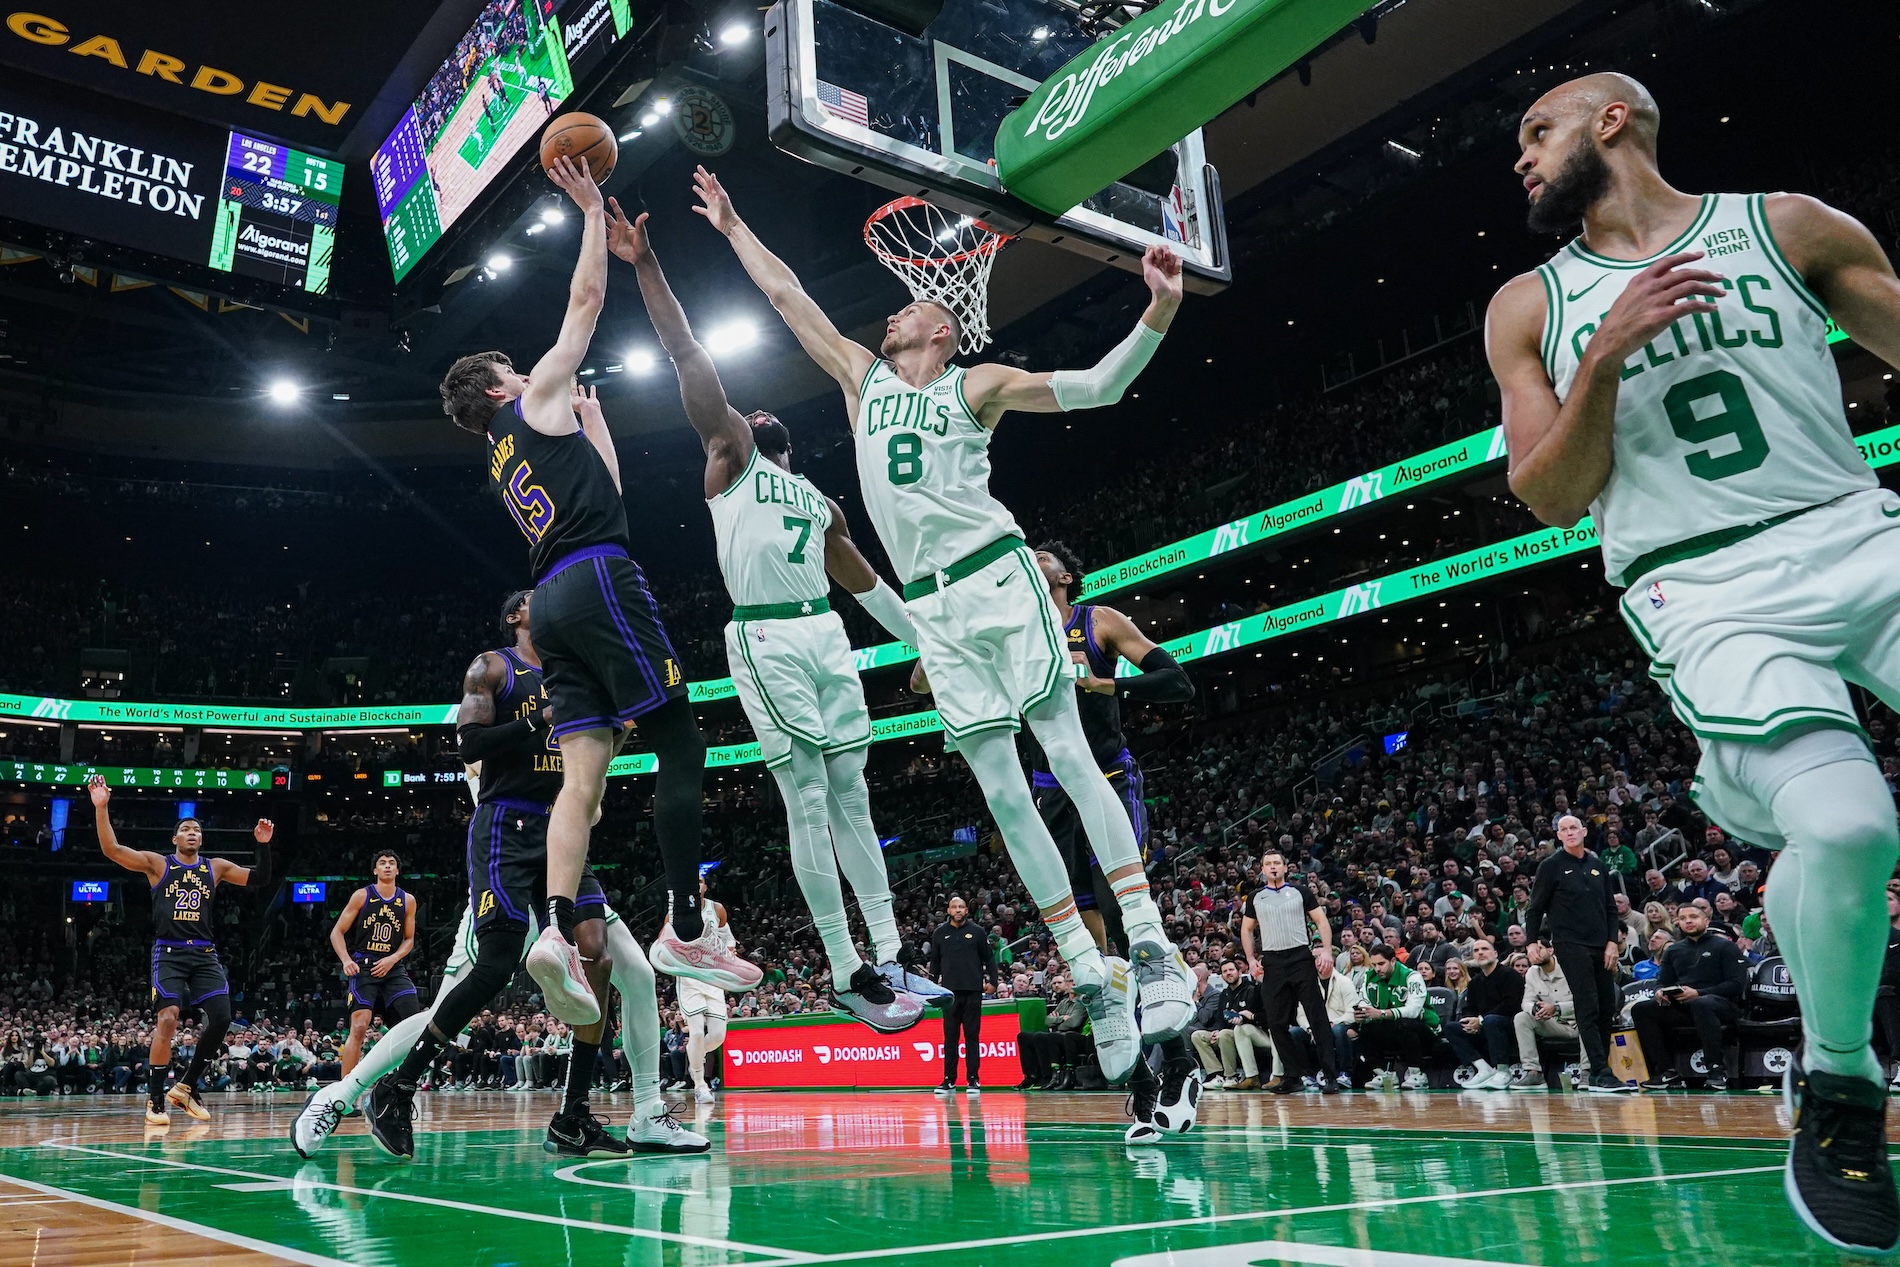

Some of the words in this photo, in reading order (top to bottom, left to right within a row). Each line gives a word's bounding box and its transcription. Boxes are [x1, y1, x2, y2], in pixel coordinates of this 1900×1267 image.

[6, 12, 351, 125] GARDEN
[695, 110, 709, 130] 2
[0, 111, 194, 188] FRANKLIN
[242, 152, 272, 175] 22
[0, 142, 205, 220] EMPLETON
[304, 168, 328, 190] 15
[230, 186, 242, 196] 20
[262, 193, 302, 214] 3:57
[315, 209, 329, 220] 1st
[239, 224, 309, 256] Algorand
[1702, 228, 1749, 248] VISTA
[238, 242, 306, 266] www.algorand.com
[1707, 239, 1751, 259] PRINT
[868, 393, 950, 437] CELTICS
[1662, 370, 1770, 481] 9
[491, 434, 514, 482] REAVES
[888, 433, 922, 486] 8
[1394, 447, 1468, 486] Algorand
[503, 460, 555, 546] 15
[756, 471, 826, 528] CELTICS
[1260, 498, 1323, 532] Algorand
[783, 516, 811, 564] 7
[1119, 549, 1186, 580] Blockchain
[1410, 572, 1440, 589] The
[1446, 552, 1508, 579] World's
[1514, 534, 1559, 560] Most
[1263, 603, 1324, 632] Algorand
[694, 684, 737, 698] Algoran
[99, 707, 120, 717] The
[125, 708, 169, 718] World's
[174, 709, 203, 719] Most
[206, 711, 258, 721] Powerful
[264, 713, 285, 722] and
[289, 712, 357, 723] Sustainable
[360, 711, 422, 721] Blockchain
[872, 717, 936, 736] Sustainable
[534, 755, 564, 772] LAKE
[710, 751, 731, 762] The
[735, 748, 762, 759] World
[607, 760, 642, 774] gorand
[16, 770, 22, 780] 2
[35, 772, 42, 781] 6
[55, 773, 67, 782] 47
[123, 775, 136, 784] 1/6
[154, 776, 160, 785] 5
[175, 777, 182, 785] 0
[197, 778, 203, 786] 6
[217, 778, 227, 787] 10
[275, 776, 286, 785] 20
[386, 775, 400, 784] TD
[404, 773, 426, 783] Bank
[434, 773, 454, 782] 7:59
[165, 880, 179, 897] LOS
[182, 870, 210, 899] ANGELES
[175, 889, 201, 910] 28
[173, 911, 200, 921] LAKERS
[363, 913, 376, 929] LOS
[379, 904, 401, 932] ANGELES
[372, 922, 392, 942] 10
[367, 941, 391, 952] LAKERS
[1430, 996, 1445, 1005] ltics
[745, 1049, 802, 1064] DOORDASH
[834, 1046, 900, 1061] DOORDASH
